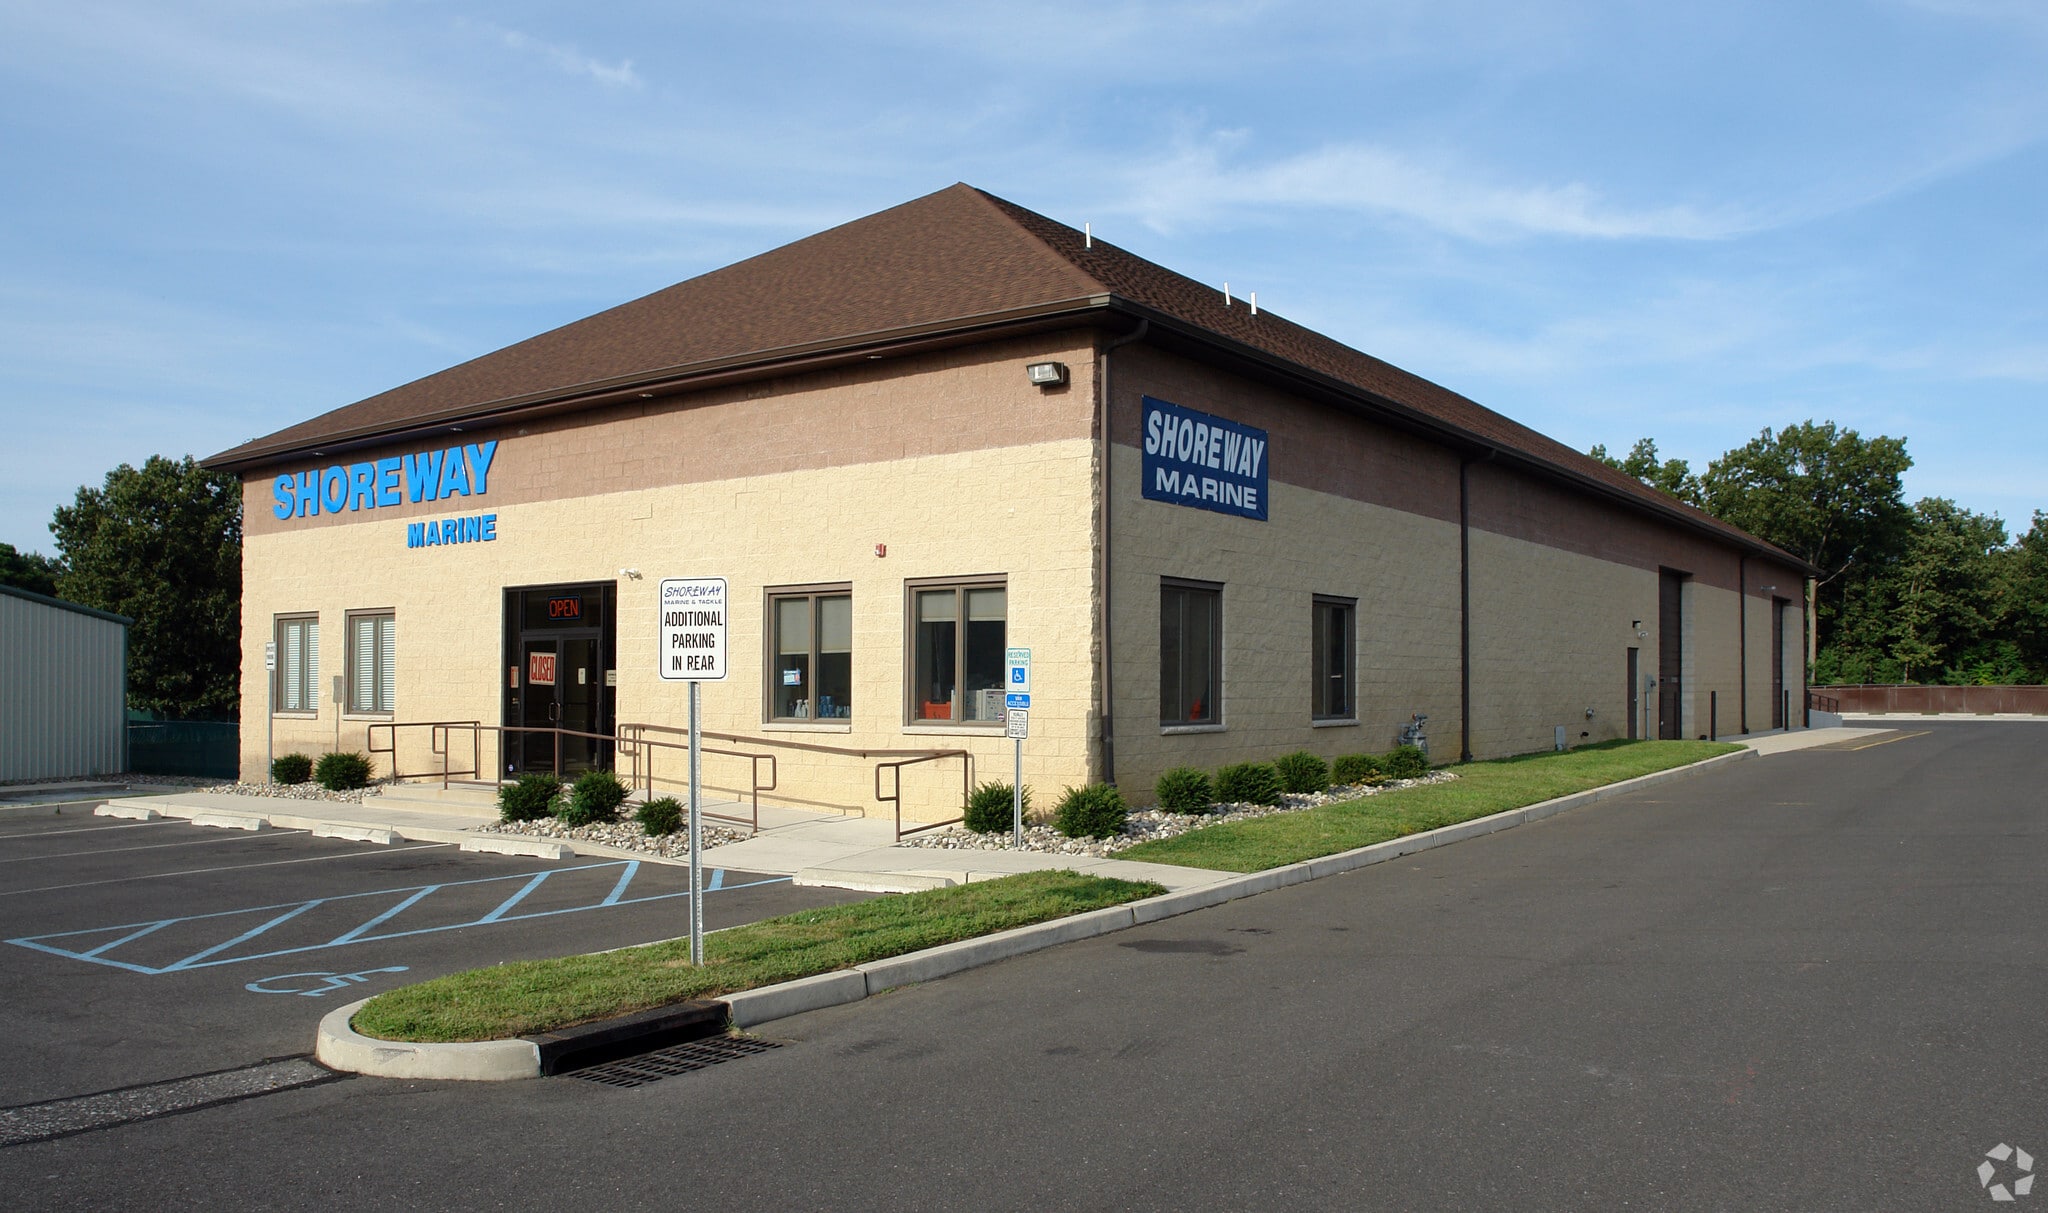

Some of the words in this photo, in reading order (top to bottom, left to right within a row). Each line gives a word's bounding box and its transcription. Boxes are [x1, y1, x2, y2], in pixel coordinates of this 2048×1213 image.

[1145, 410, 1265, 479] SHOREWAY
[272, 440, 498, 520] SHOREWAY
[1156, 466, 1257, 510] MARINE
[407, 513, 497, 548] MARINE
[664, 586, 722, 598] SHOREWAY
[549, 599, 579, 617] OPEN
[664, 611, 723, 627] ADDITIONAL
[672, 633, 715, 649] PARKING
[531, 655, 555, 682] CLOSED
[672, 655, 682, 671] IN
[687, 655, 715, 671] REAR
